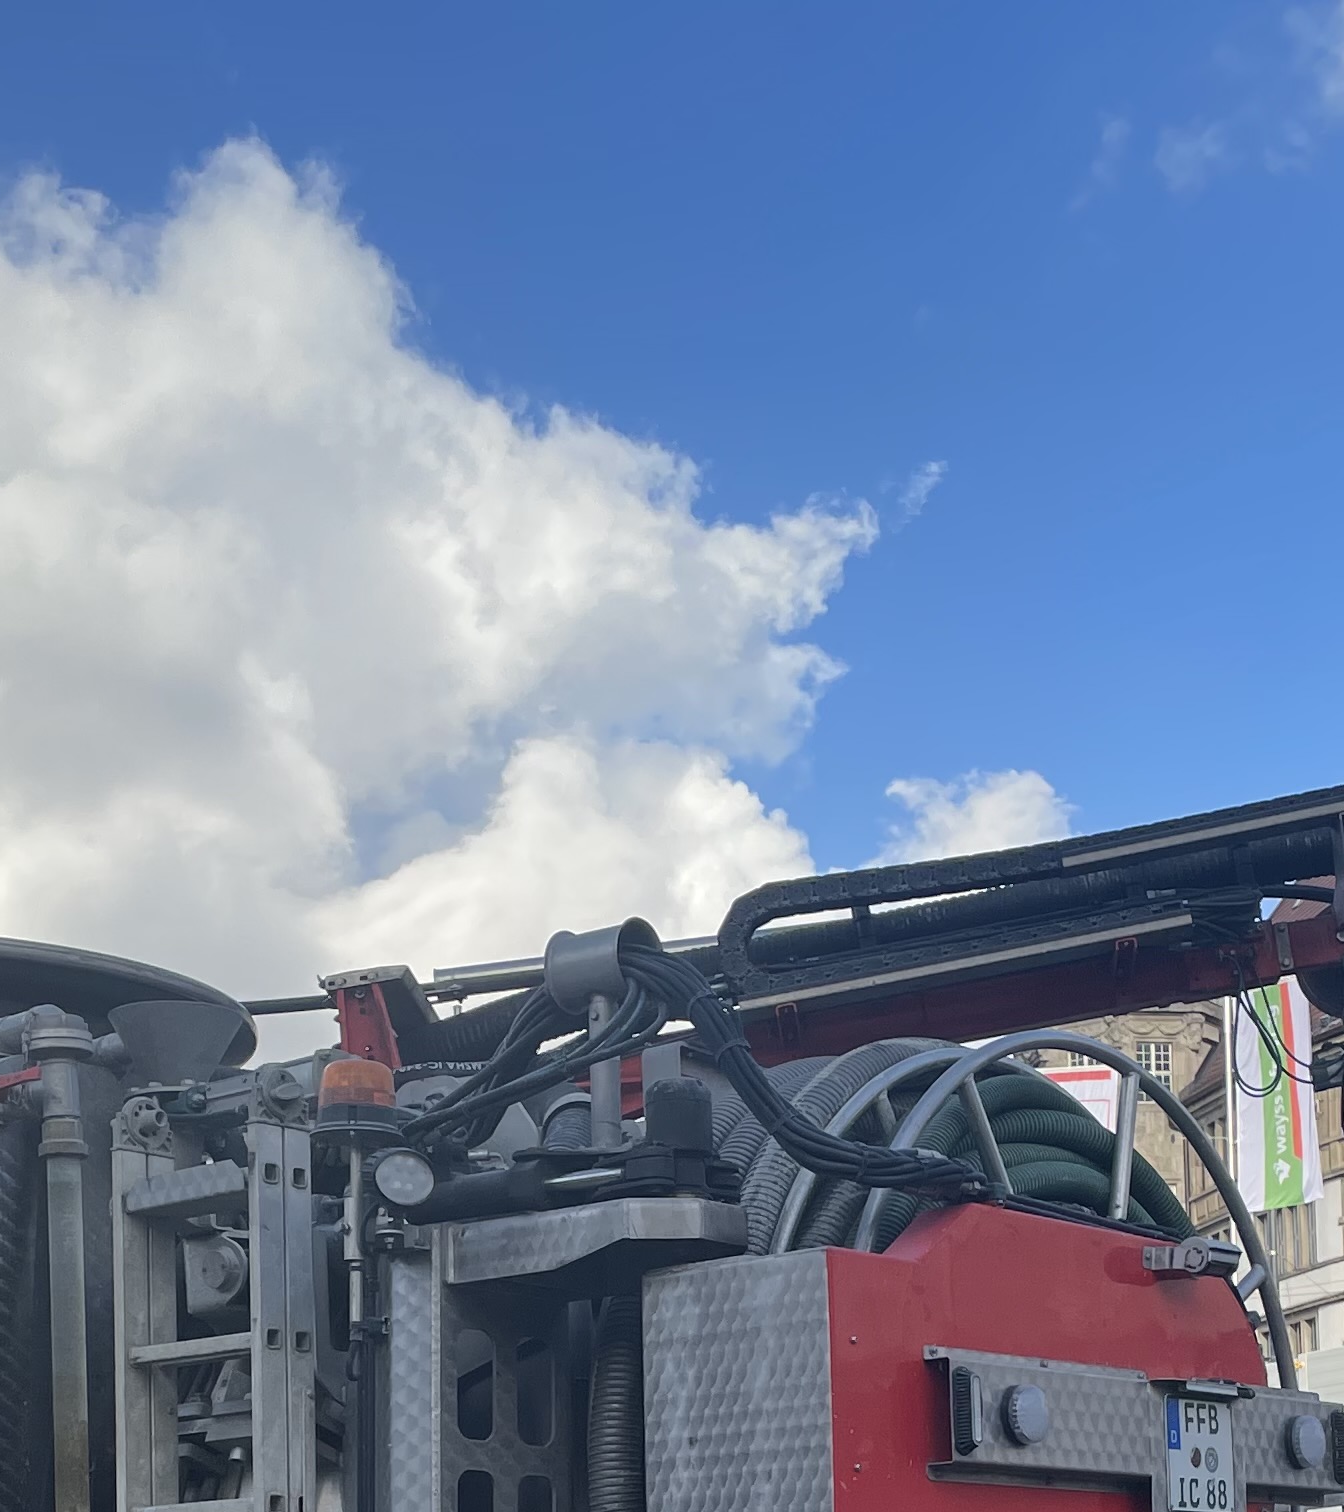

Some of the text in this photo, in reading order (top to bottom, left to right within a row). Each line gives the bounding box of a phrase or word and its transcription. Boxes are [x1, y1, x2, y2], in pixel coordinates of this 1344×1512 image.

[1274, 1094, 1290, 1156] wayss
[1184, 1402, 1219, 1435] FFB
[1170, 1430, 1178, 1444] D
[1178, 1477, 1228, 1510] IC 88
